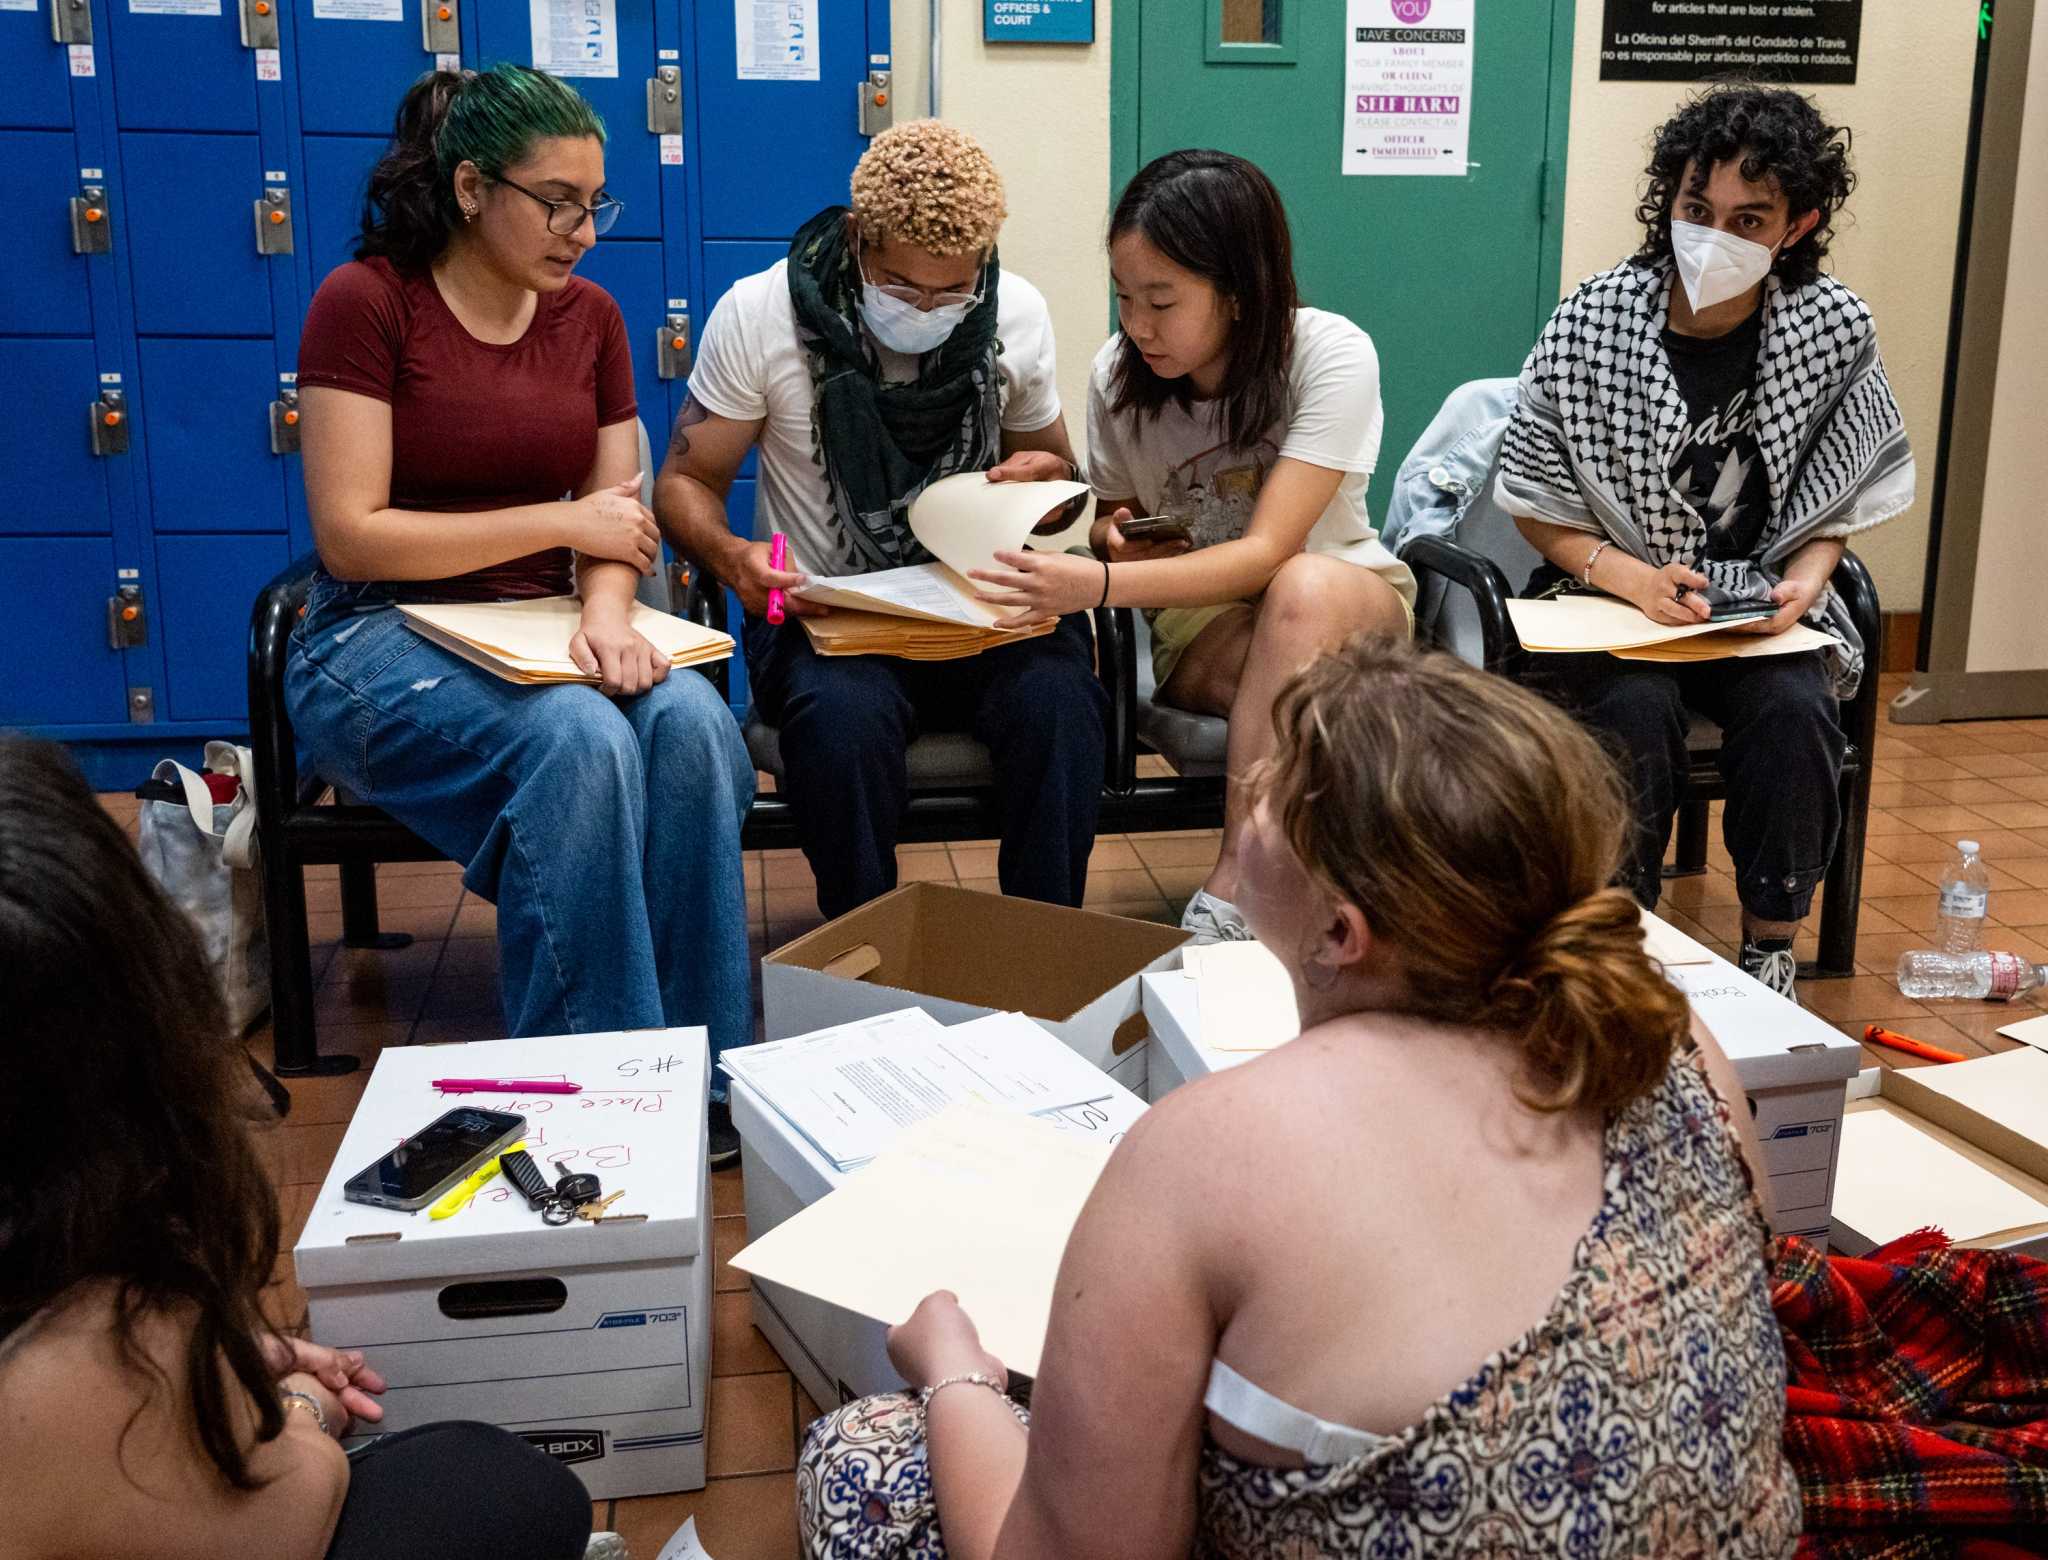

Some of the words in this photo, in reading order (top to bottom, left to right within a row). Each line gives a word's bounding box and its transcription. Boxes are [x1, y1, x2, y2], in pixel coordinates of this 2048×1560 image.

[993, 3, 1040, 14] OFFICES
[1042, 4, 1051, 14] &
[1391, 1, 1428, 16] YOU
[1652, 2, 1667, 14] for
[1668, 2, 1706, 14] articles
[1707, 3, 1727, 15] that
[1729, 5, 1746, 15] are
[1749, 4, 1767, 15] lost
[1769, 6, 1780, 16] or
[1782, 4, 1816, 17] stolen.
[993, 15, 1033, 25] COURT
[1357, 29, 1391, 41] HAVE
[1394, 29, 1464, 42] CONCERNS
[1615, 33, 1630, 45] La
[1631, 33, 1668, 46] Oficina
[1669, 34, 1686, 46] del
[1734, 35, 1751, 48] del
[1752, 35, 1799, 48] Condado
[1800, 36, 1815, 49] de
[1816, 36, 1847, 49] Travis
[1601, 51, 1616, 60] no
[1617, 51, 1630, 61] es
[1631, 50, 1694, 64] responsable
[1695, 52, 1713, 65] por
[1757, 52, 1800, 65] perdidos
[1801, 55, 1810, 64] o
[1358, 96, 1400, 112] SELF
[1403, 97, 1458, 113] HARM
[580, 1094, 664, 1113] Place
[550, 1439, 595, 1454] BOX
